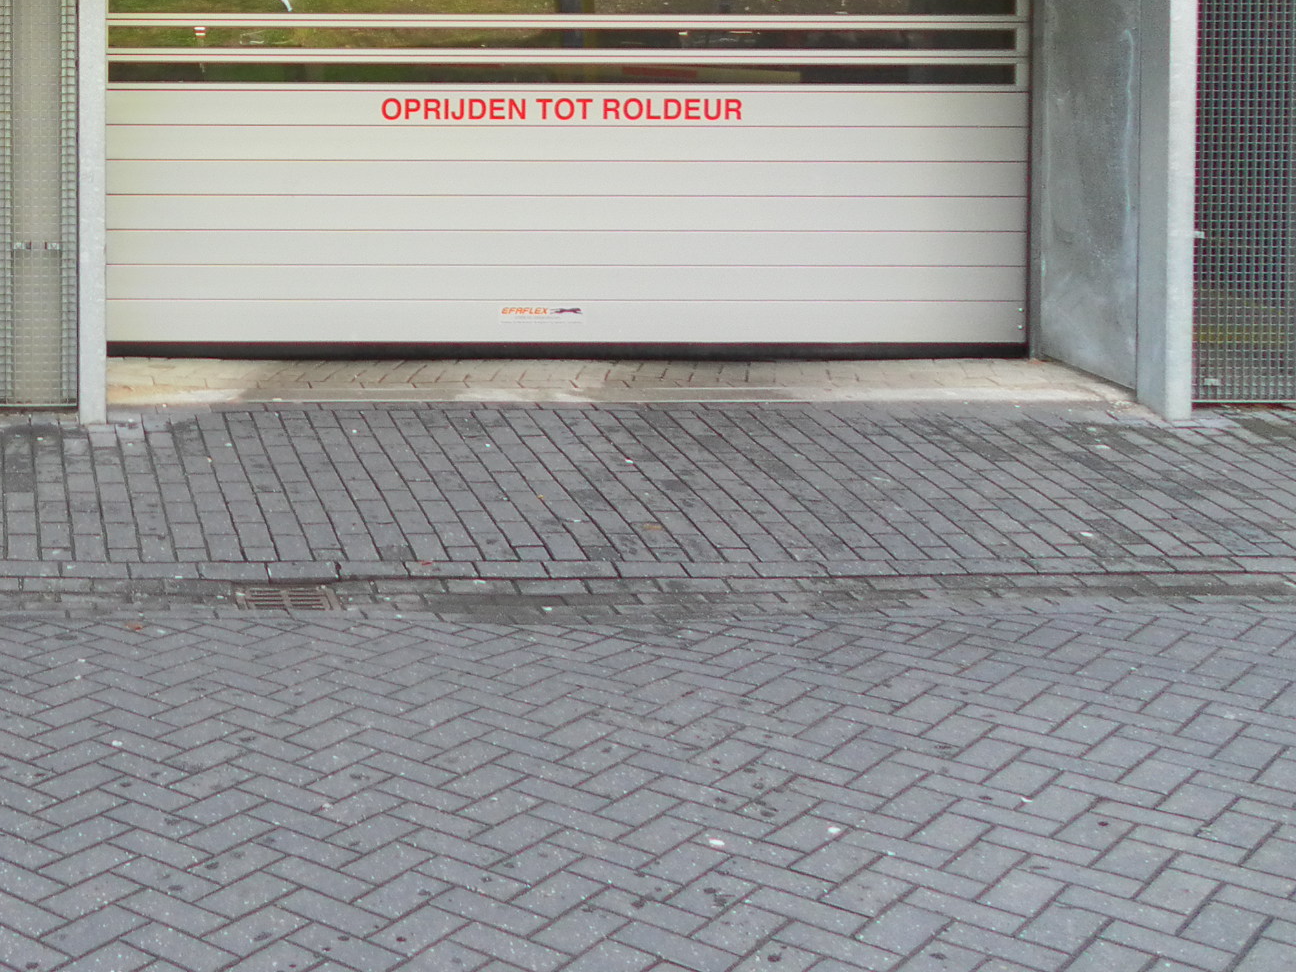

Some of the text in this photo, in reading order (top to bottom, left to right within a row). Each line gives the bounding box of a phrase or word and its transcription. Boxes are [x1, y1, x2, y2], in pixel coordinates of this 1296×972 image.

[381, 98, 743, 120] OPRIJDEN TOT ROLDEUR
[501, 307, 548, 315] EFAFLEX
